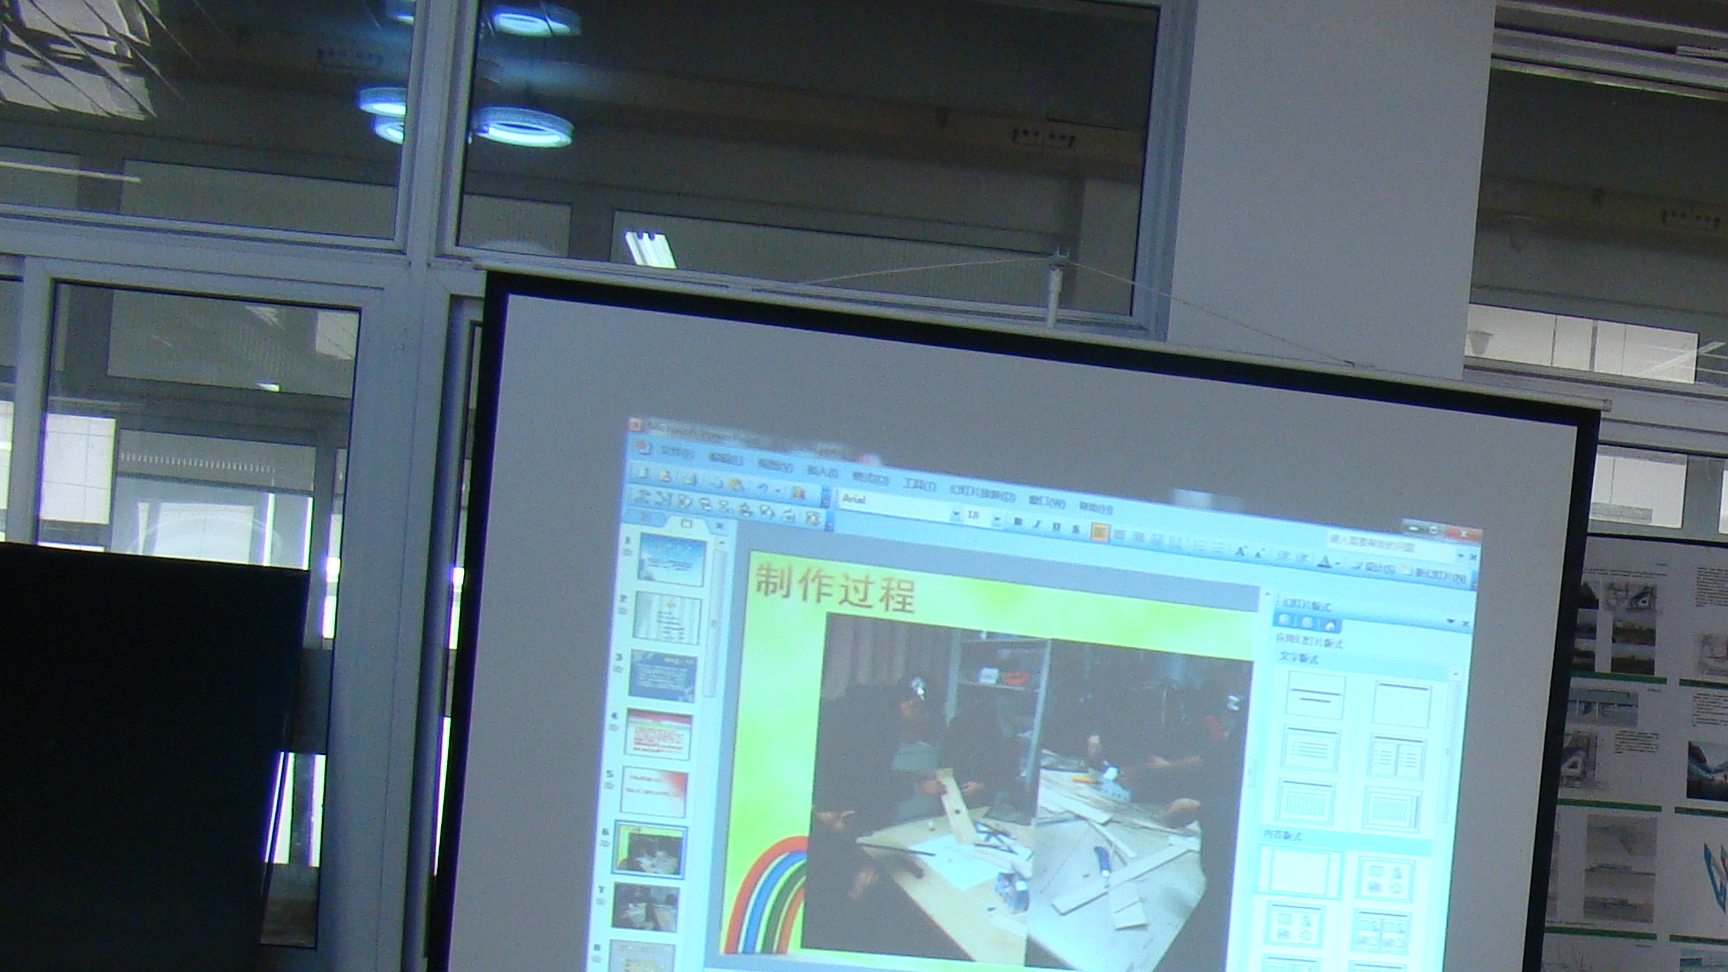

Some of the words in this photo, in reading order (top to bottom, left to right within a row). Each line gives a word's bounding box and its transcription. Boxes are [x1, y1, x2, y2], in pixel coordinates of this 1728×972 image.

[842, 493, 867, 505] Arial
[755, 562, 916, 614] 制作过程
